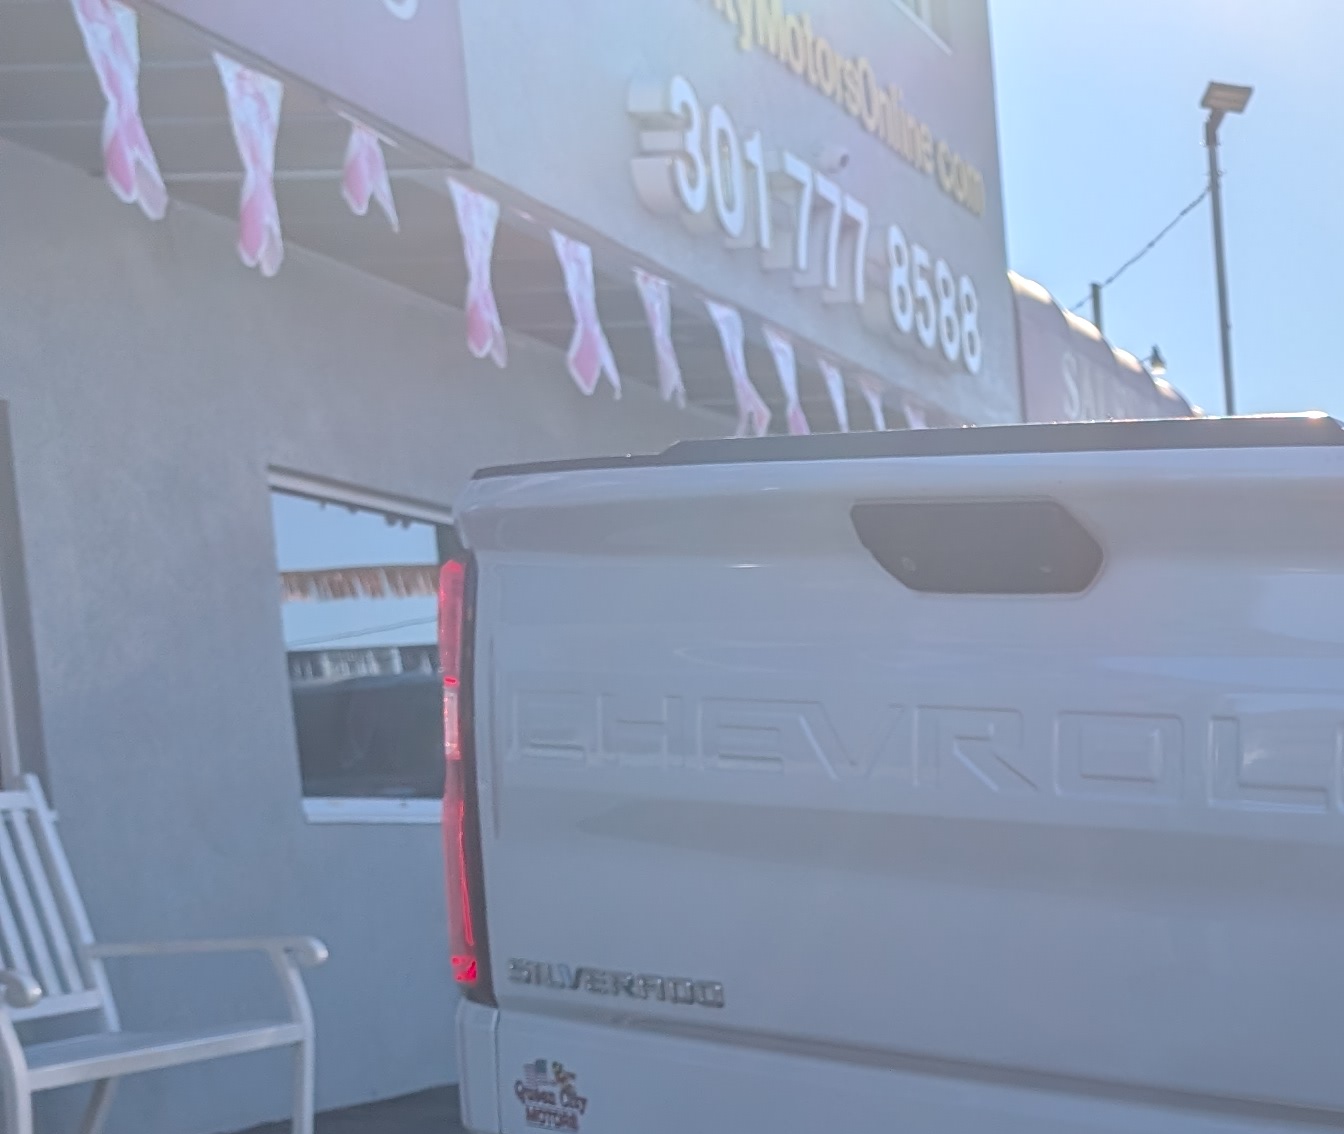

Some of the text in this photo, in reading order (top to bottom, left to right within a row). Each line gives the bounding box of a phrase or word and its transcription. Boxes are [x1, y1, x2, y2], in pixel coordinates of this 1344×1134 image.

[669, 75, 983, 375] 301 777 8588
[507, 957, 724, 1009] SILVERADO
